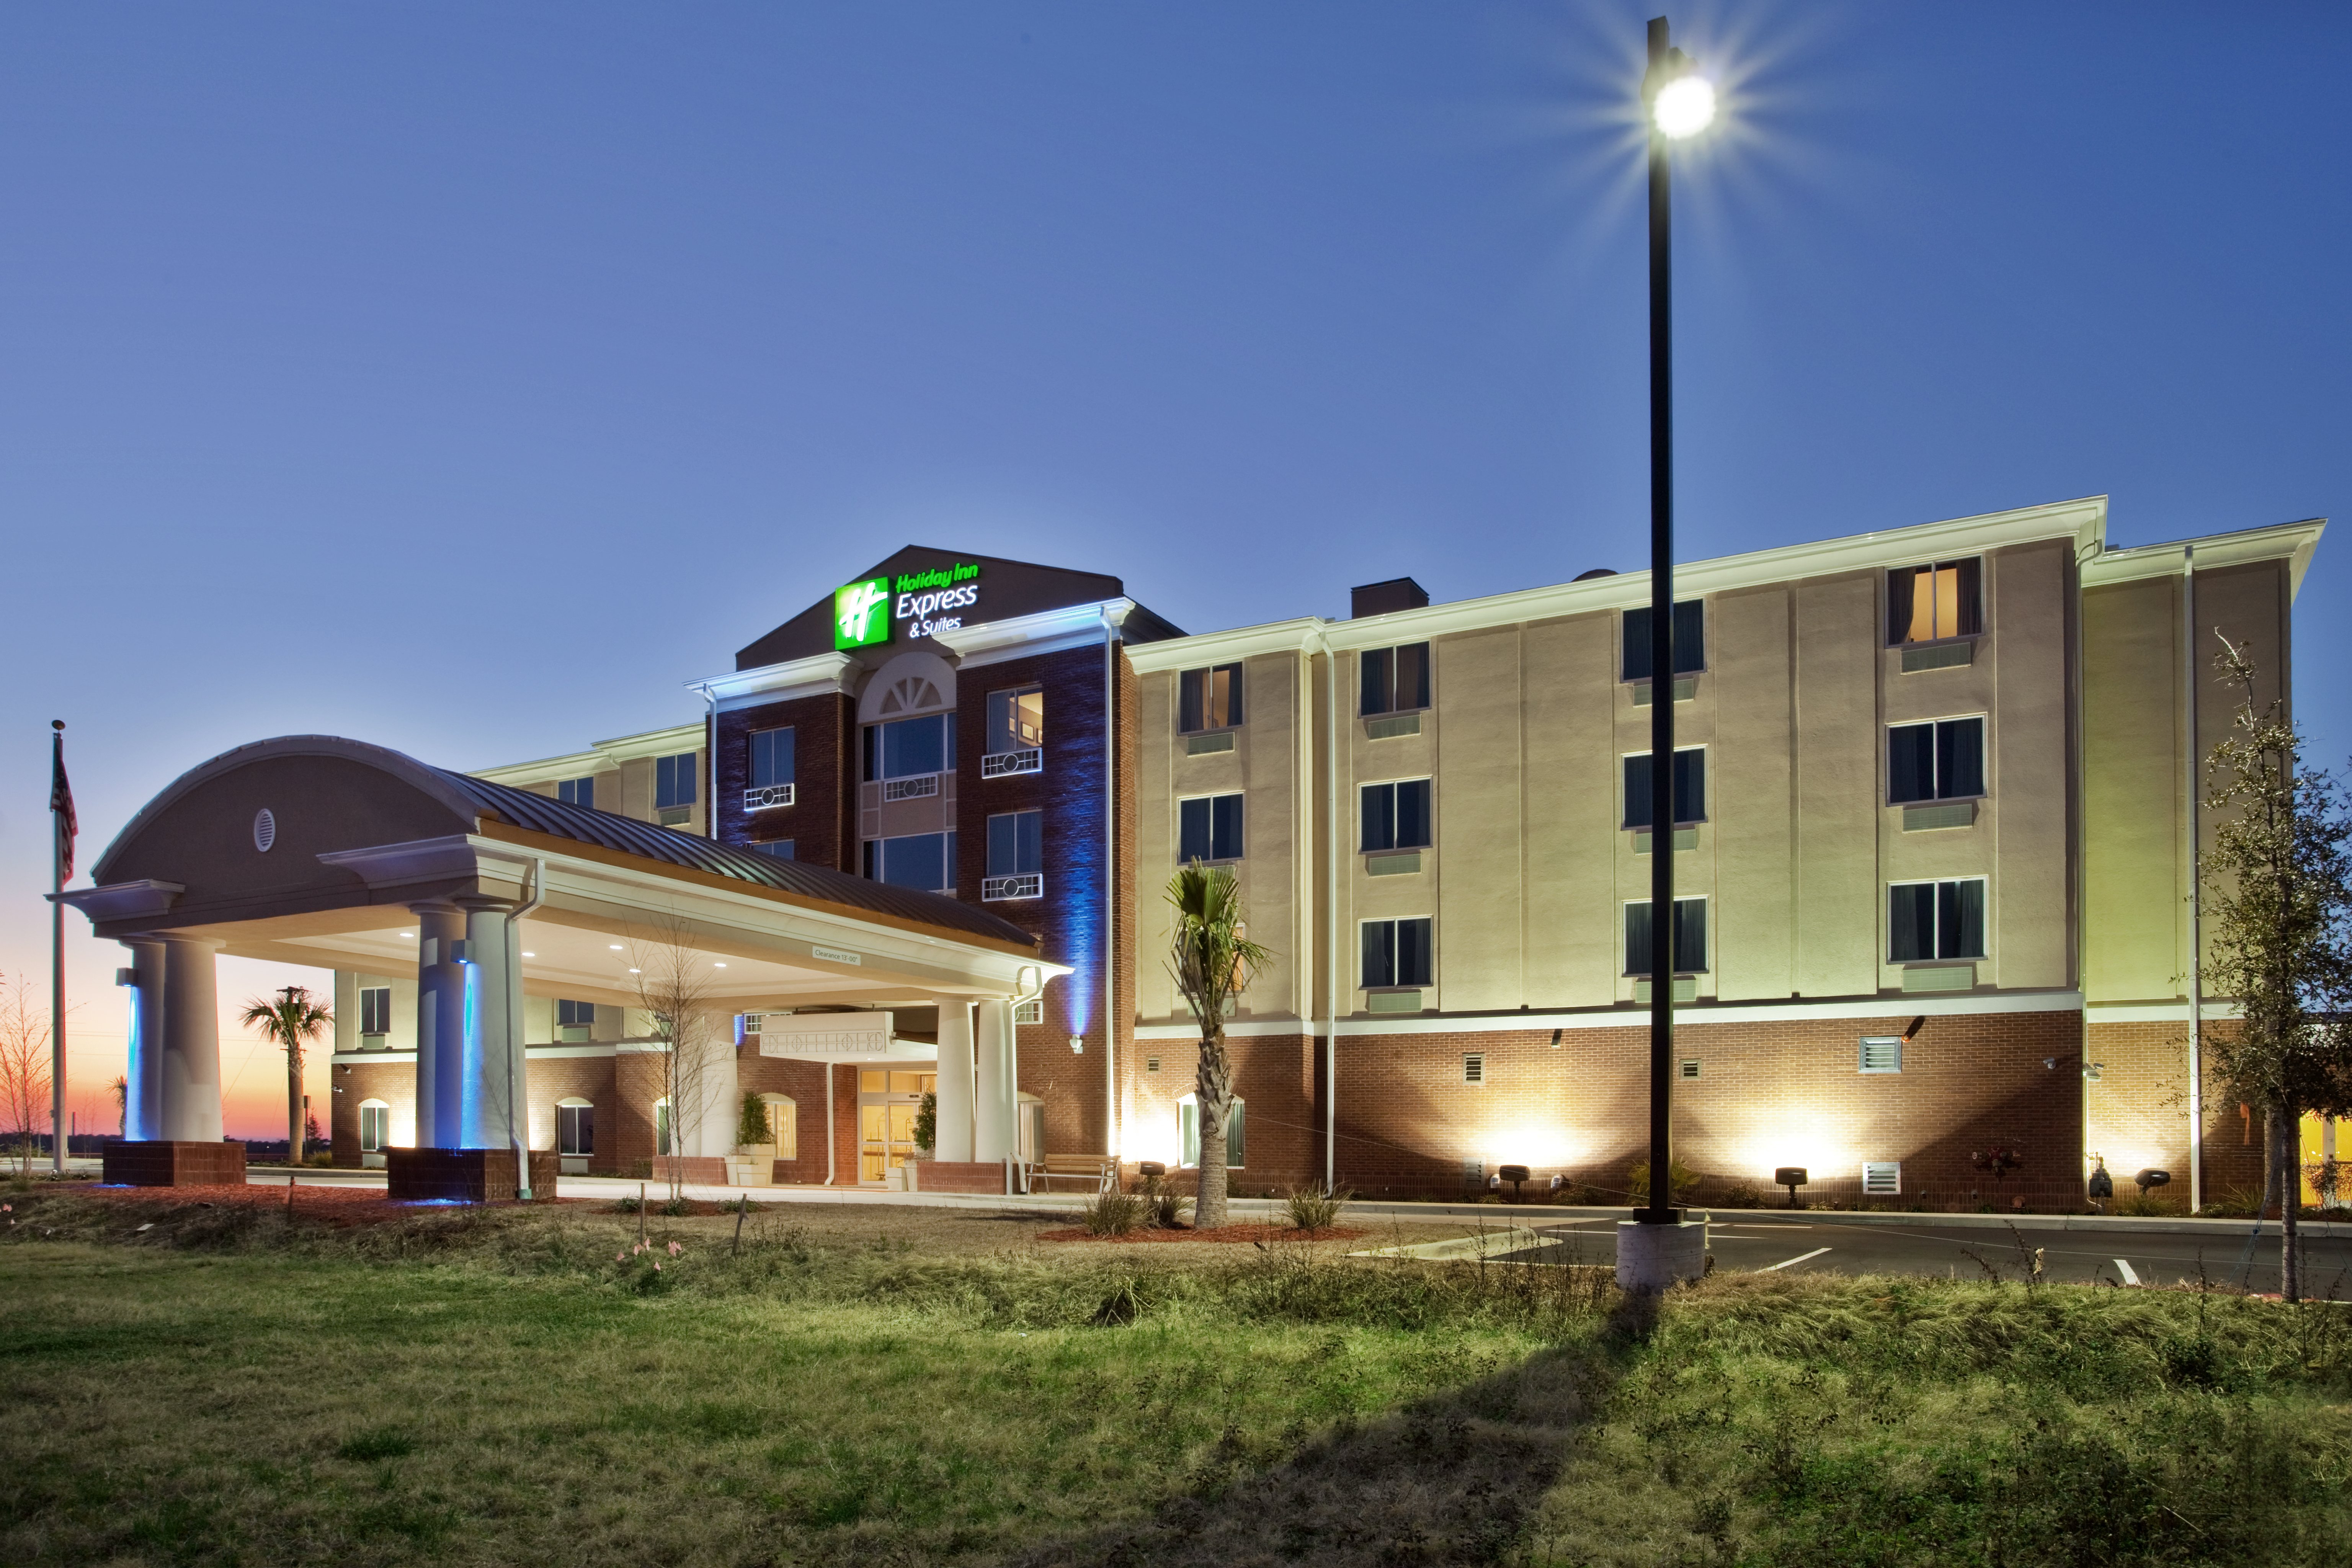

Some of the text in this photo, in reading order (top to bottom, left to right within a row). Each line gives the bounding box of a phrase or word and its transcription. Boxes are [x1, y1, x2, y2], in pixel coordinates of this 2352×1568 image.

[895, 563, 978, 593] Holiday Inn
[896, 585, 978, 621] Express
[910, 617, 961, 638] & Suites
[815, 949, 840, 959] Clearance
